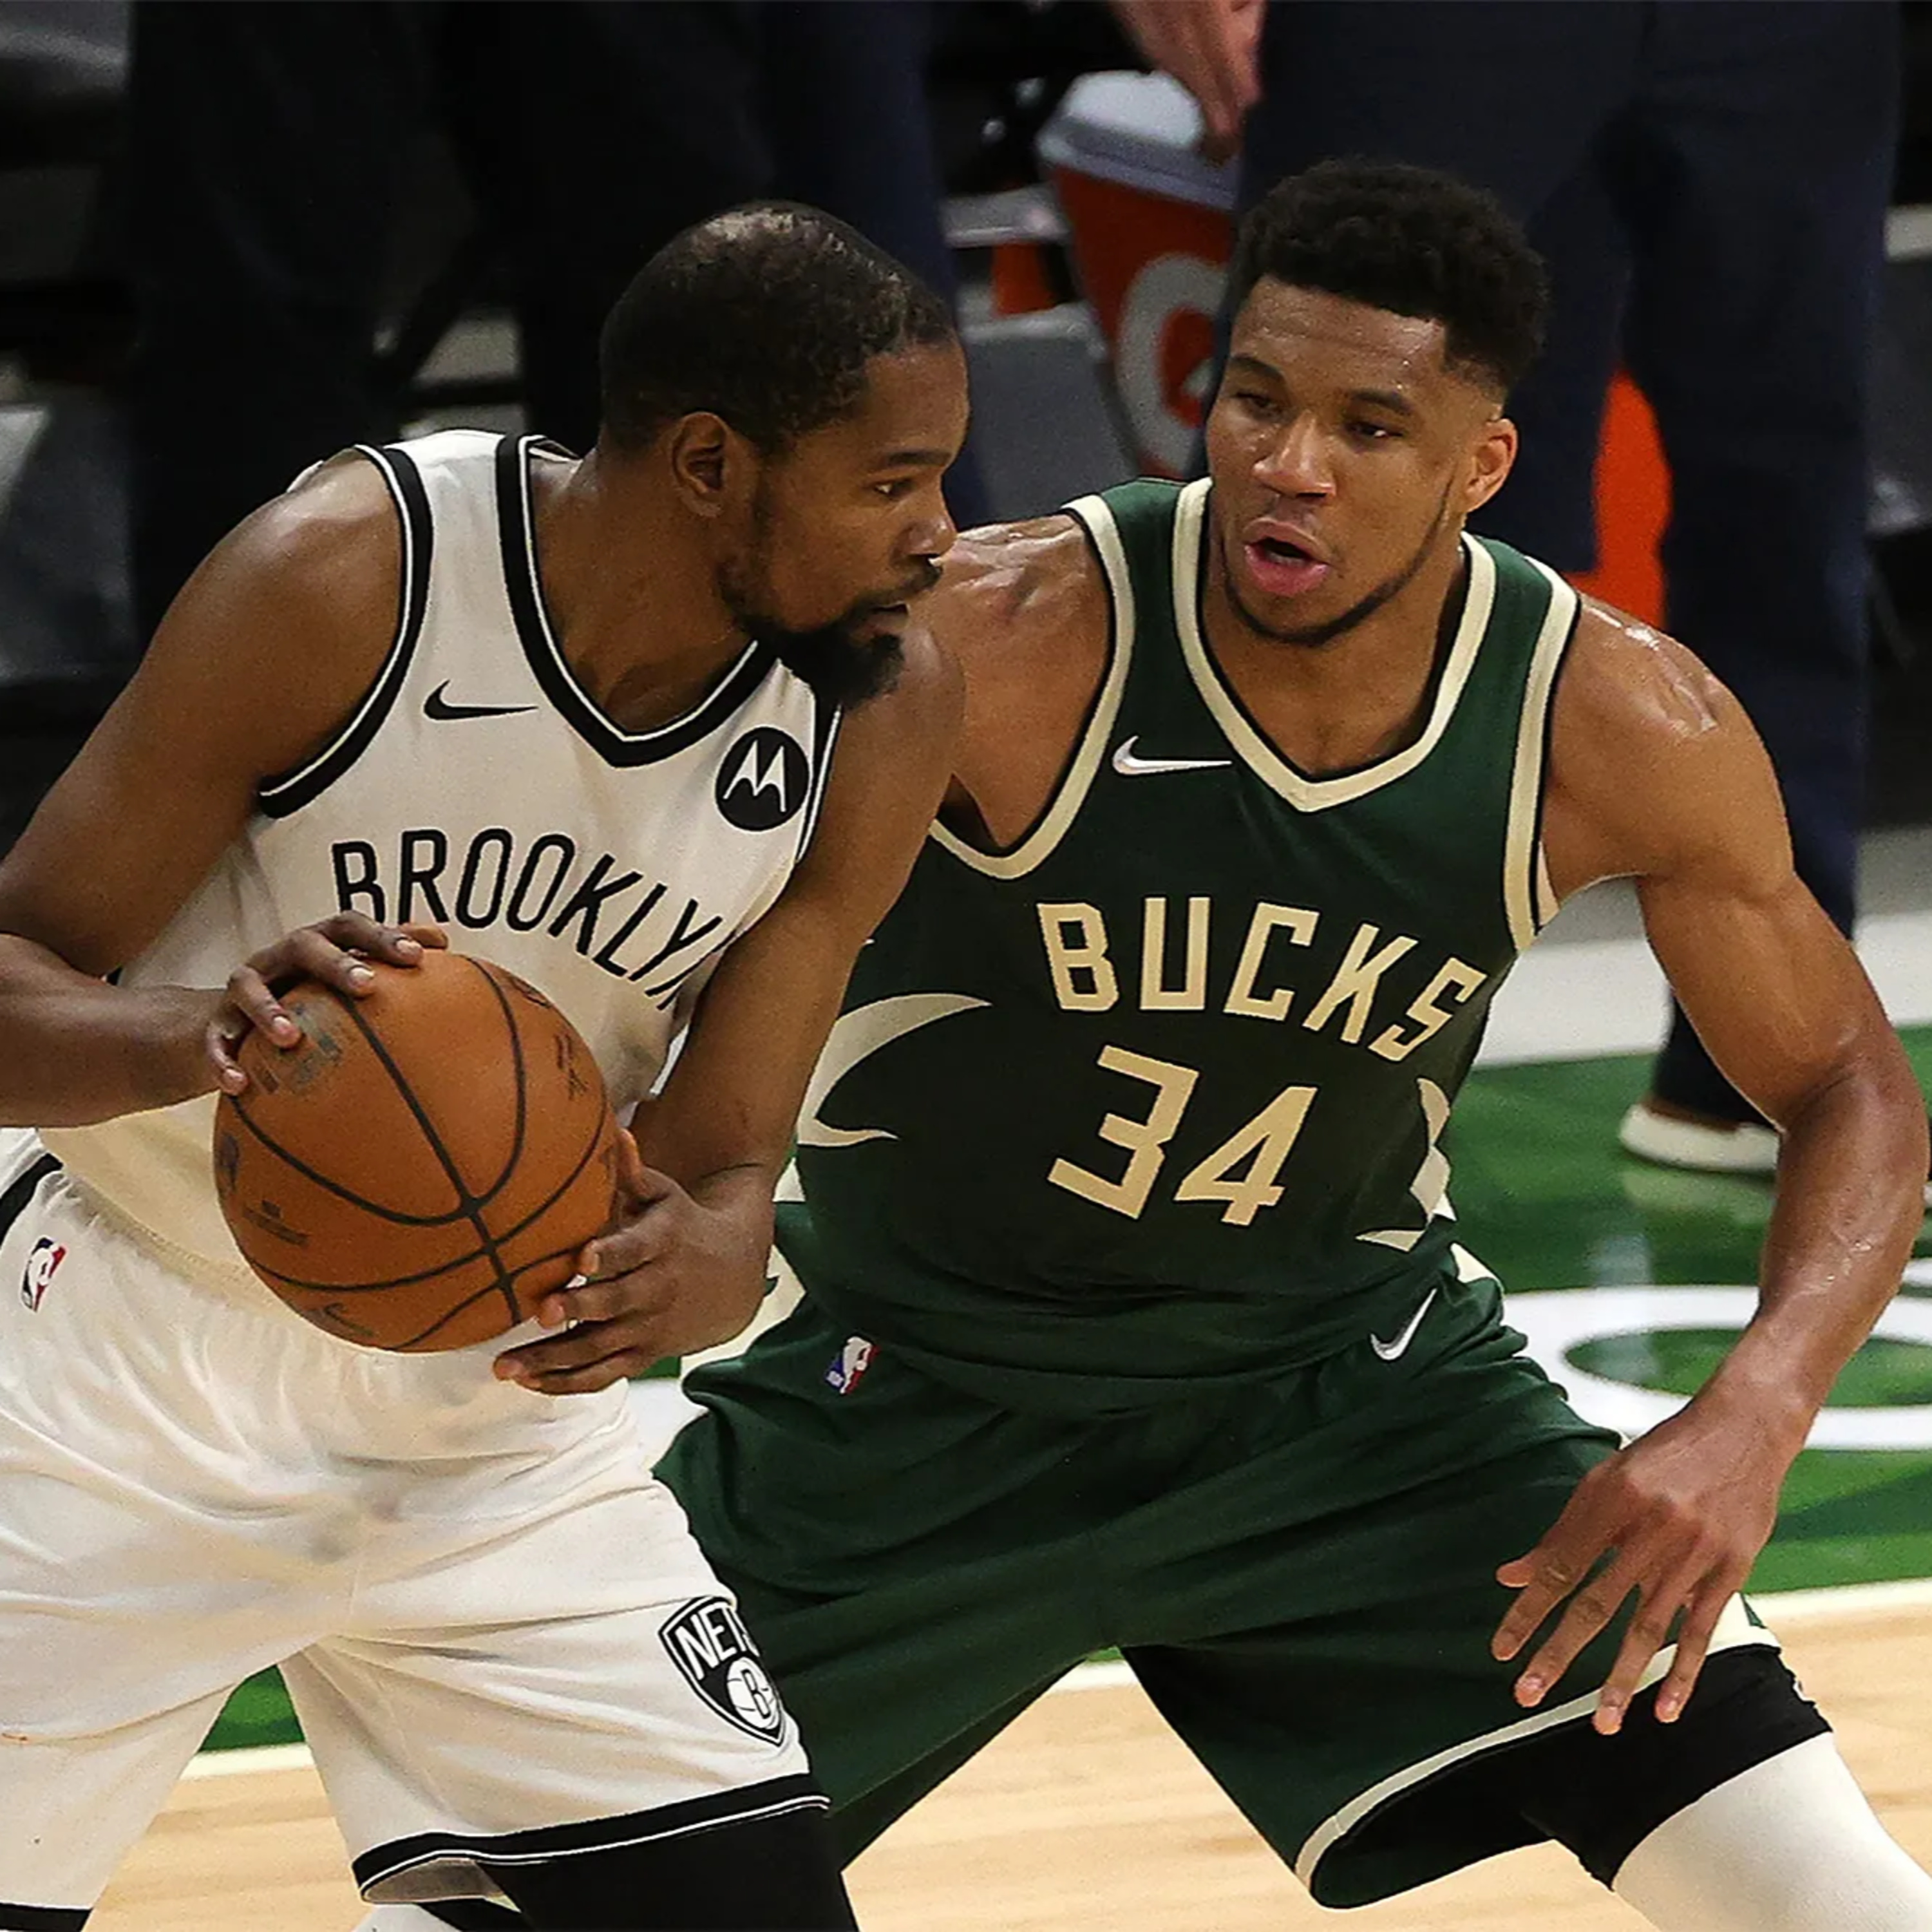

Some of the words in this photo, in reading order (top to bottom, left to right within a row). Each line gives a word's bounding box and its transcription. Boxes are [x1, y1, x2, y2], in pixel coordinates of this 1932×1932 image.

[1036, 896, 1488, 1061] BUCKS
[1046, 1044, 1318, 1226] 34
[674, 1601, 761, 1681] NET
